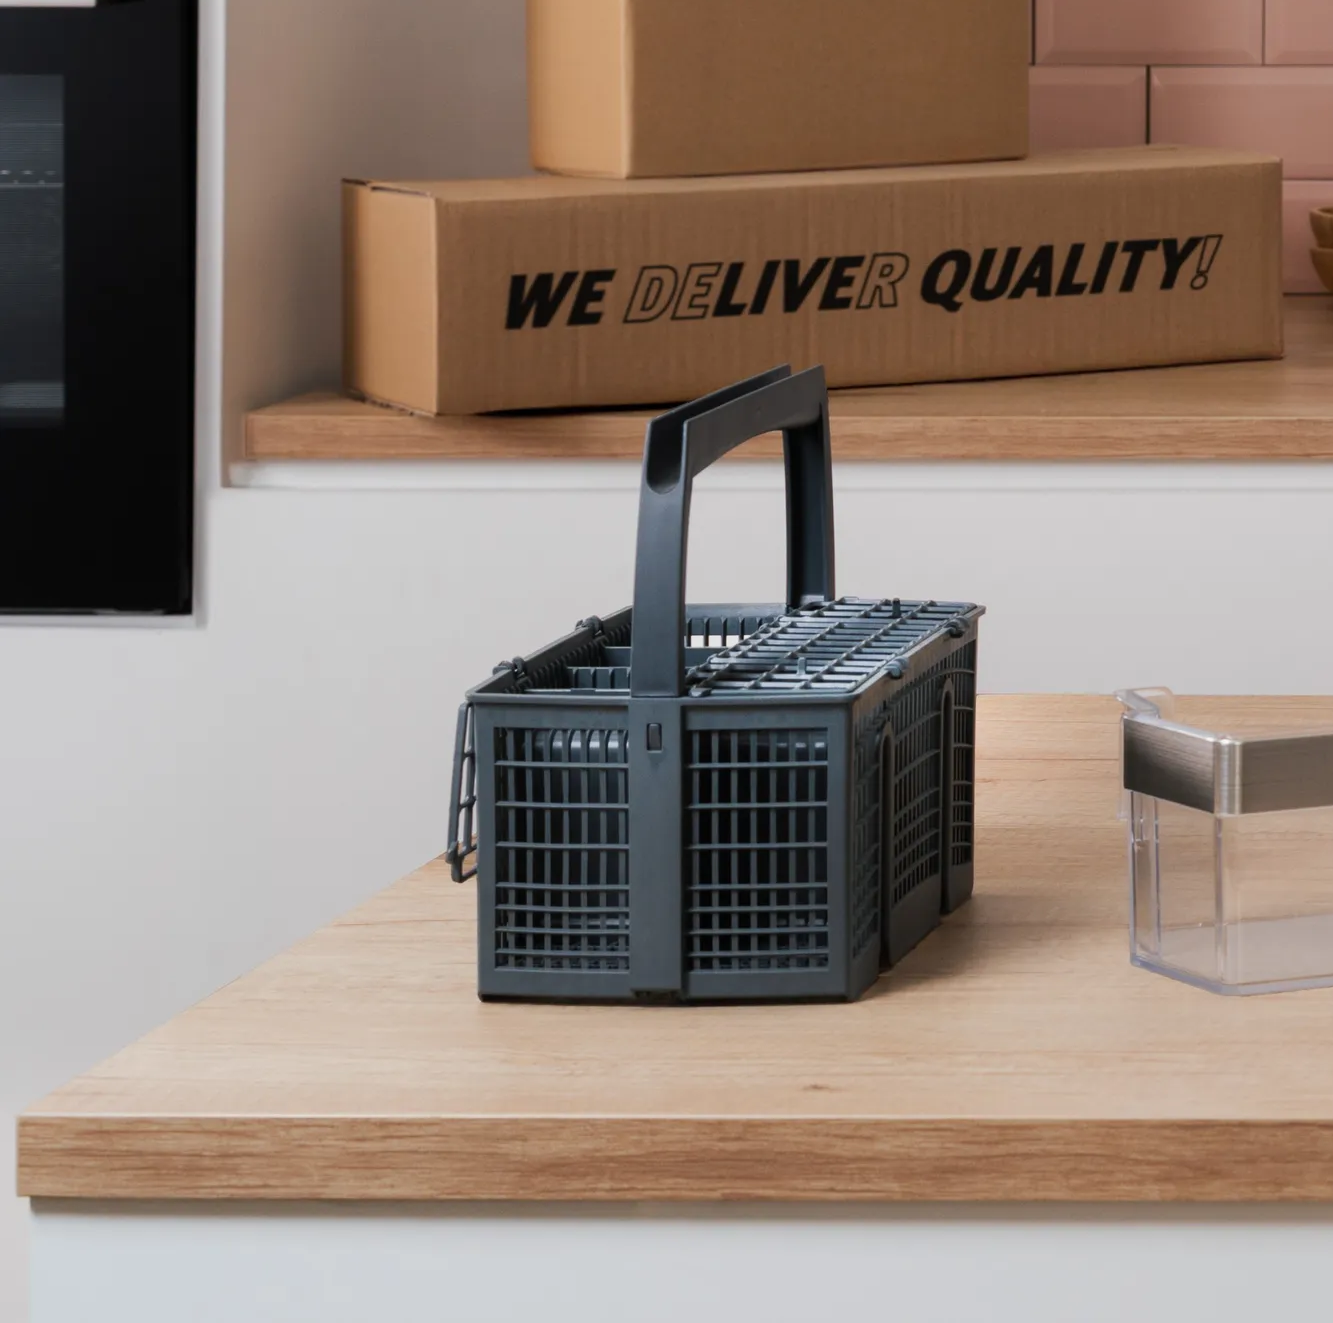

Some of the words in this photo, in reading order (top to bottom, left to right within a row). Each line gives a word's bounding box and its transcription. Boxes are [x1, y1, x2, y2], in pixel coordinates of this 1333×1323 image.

[504, 268, 616, 330] WE
[622, 252, 909, 324] DELIVER
[919, 234, 1223, 313] QUALITY!
